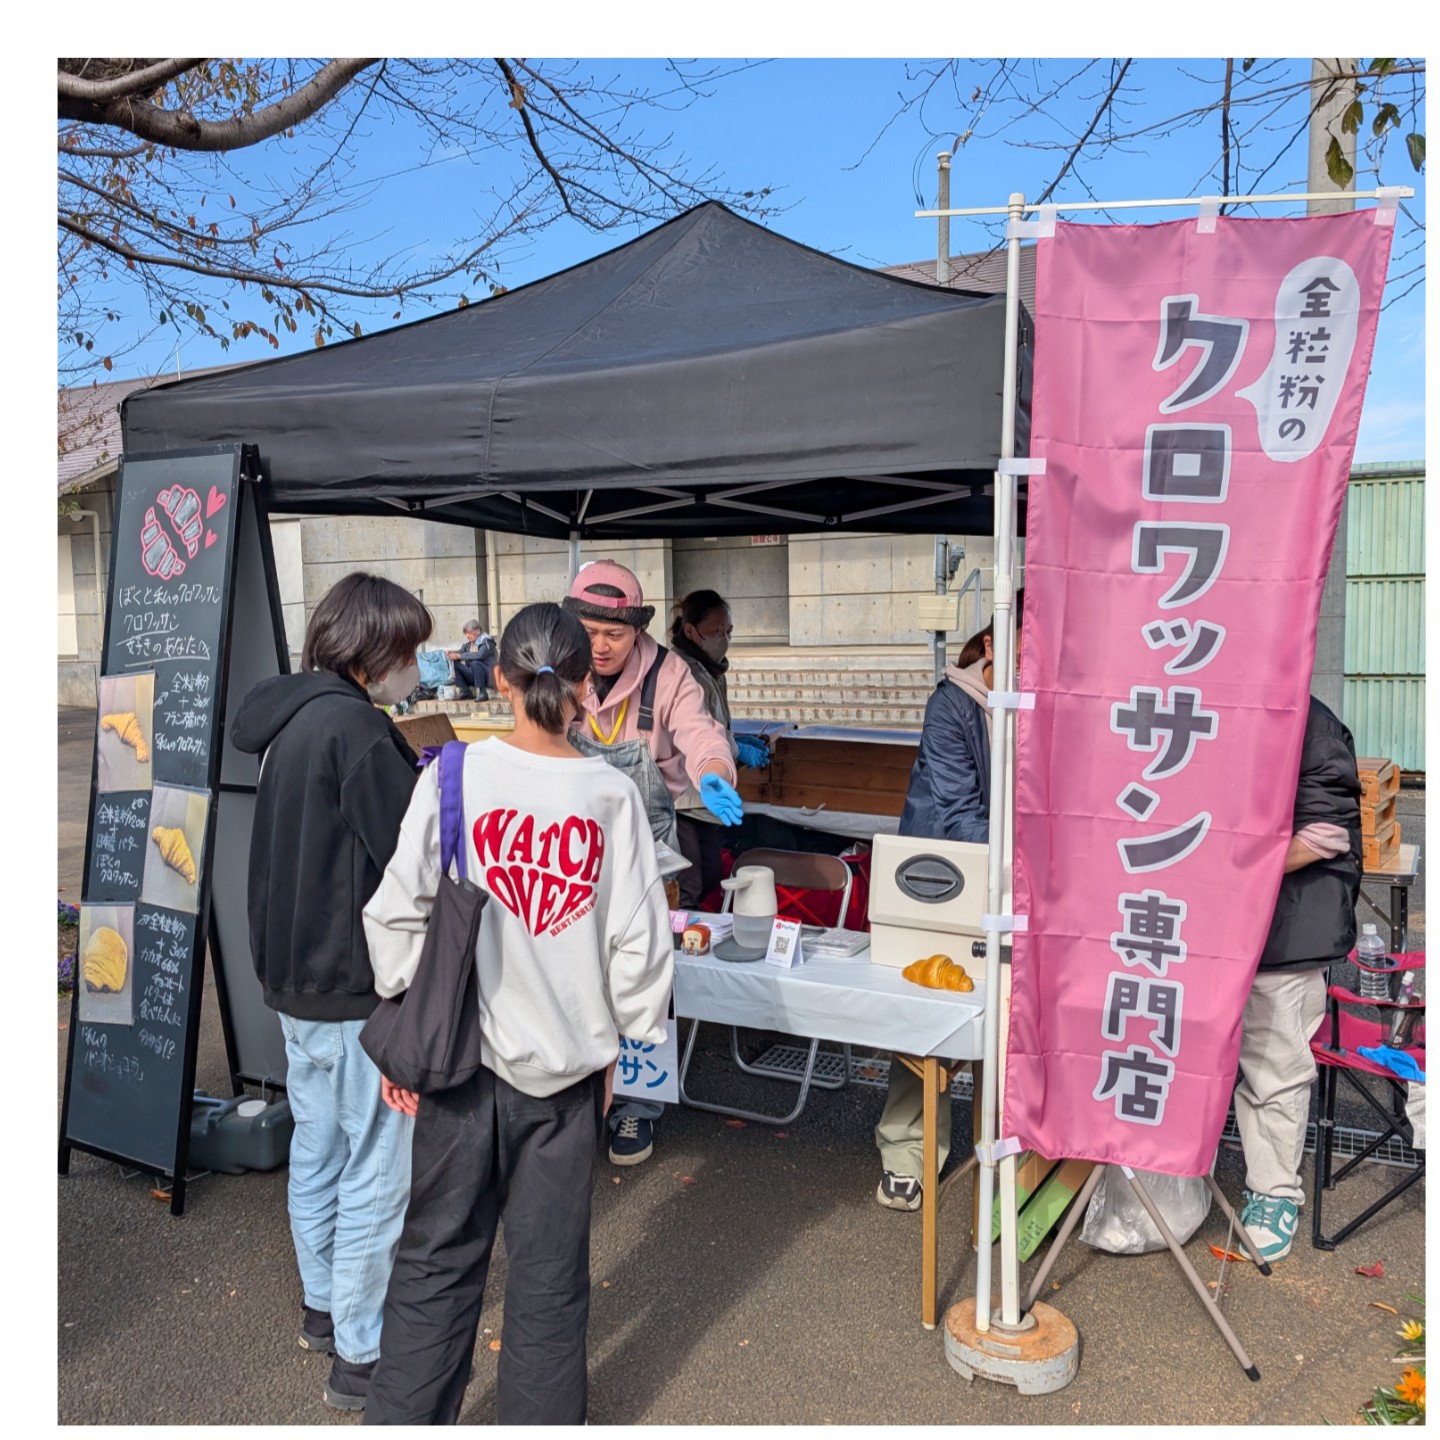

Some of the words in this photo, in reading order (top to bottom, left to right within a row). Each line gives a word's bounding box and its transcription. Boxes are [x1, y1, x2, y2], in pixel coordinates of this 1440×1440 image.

[1277, 276, 1341, 441] 全粒粉の
[1112, 295, 1250, 873] クロワッサン
[473, 808, 605, 883] WATCH
[486, 865, 593, 937] OVER
[1093, 890, 1187, 1126] 専門店
